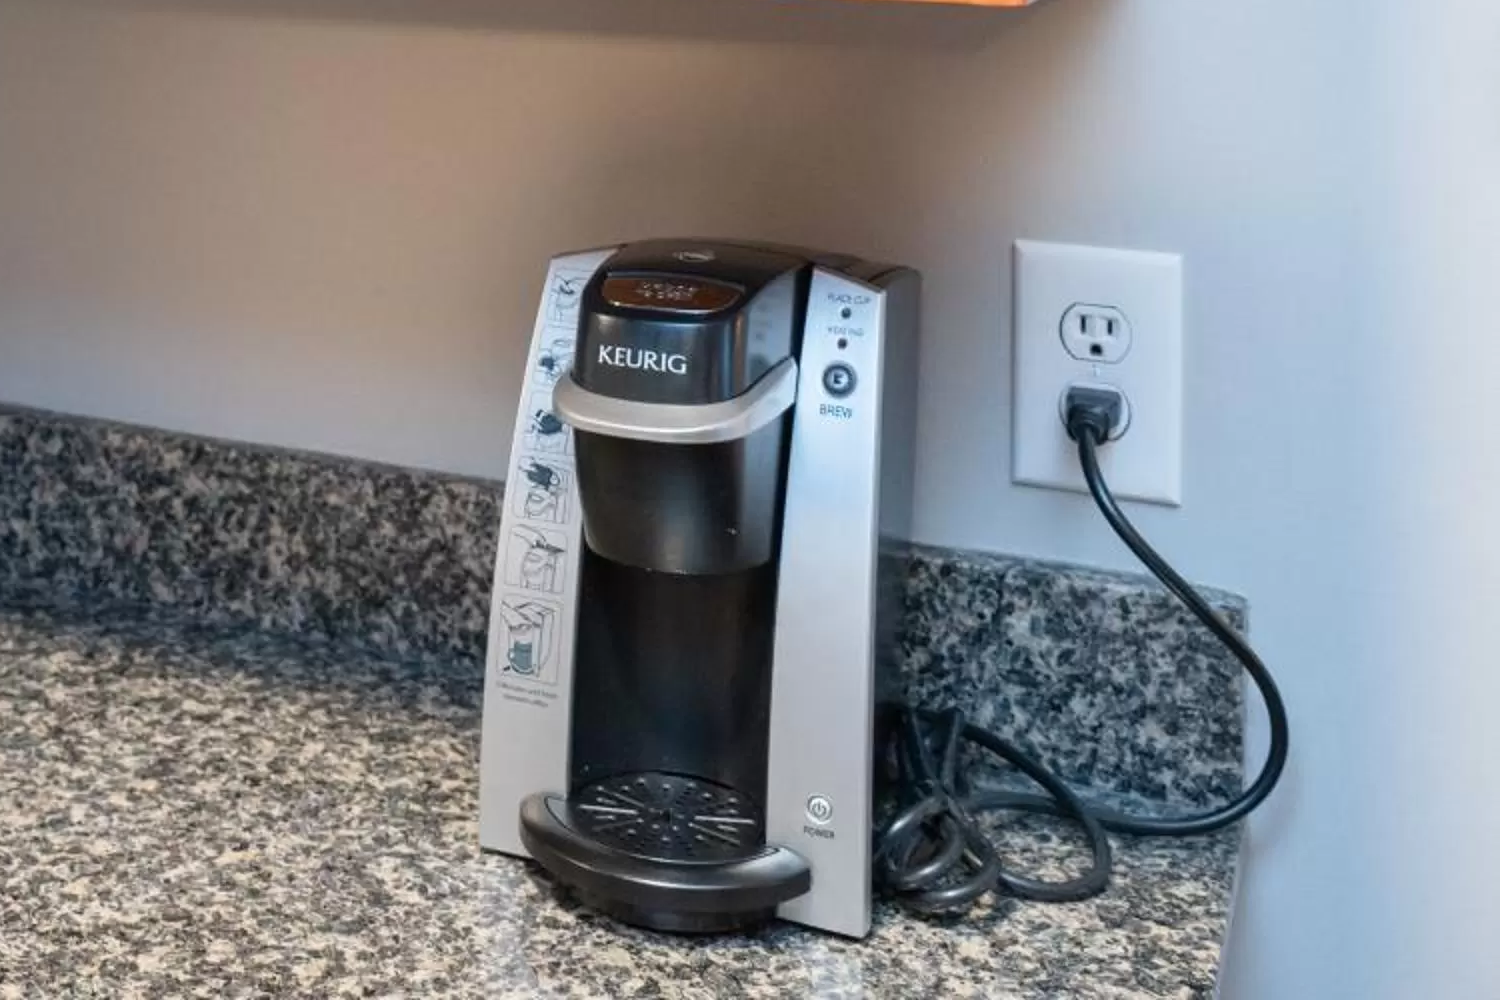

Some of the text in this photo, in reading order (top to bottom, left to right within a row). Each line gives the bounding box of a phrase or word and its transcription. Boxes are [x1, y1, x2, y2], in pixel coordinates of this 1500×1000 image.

[598, 344, 688, 375] KEURIG
[820, 403, 853, 420] BREW
[803, 825, 835, 839] POWER
